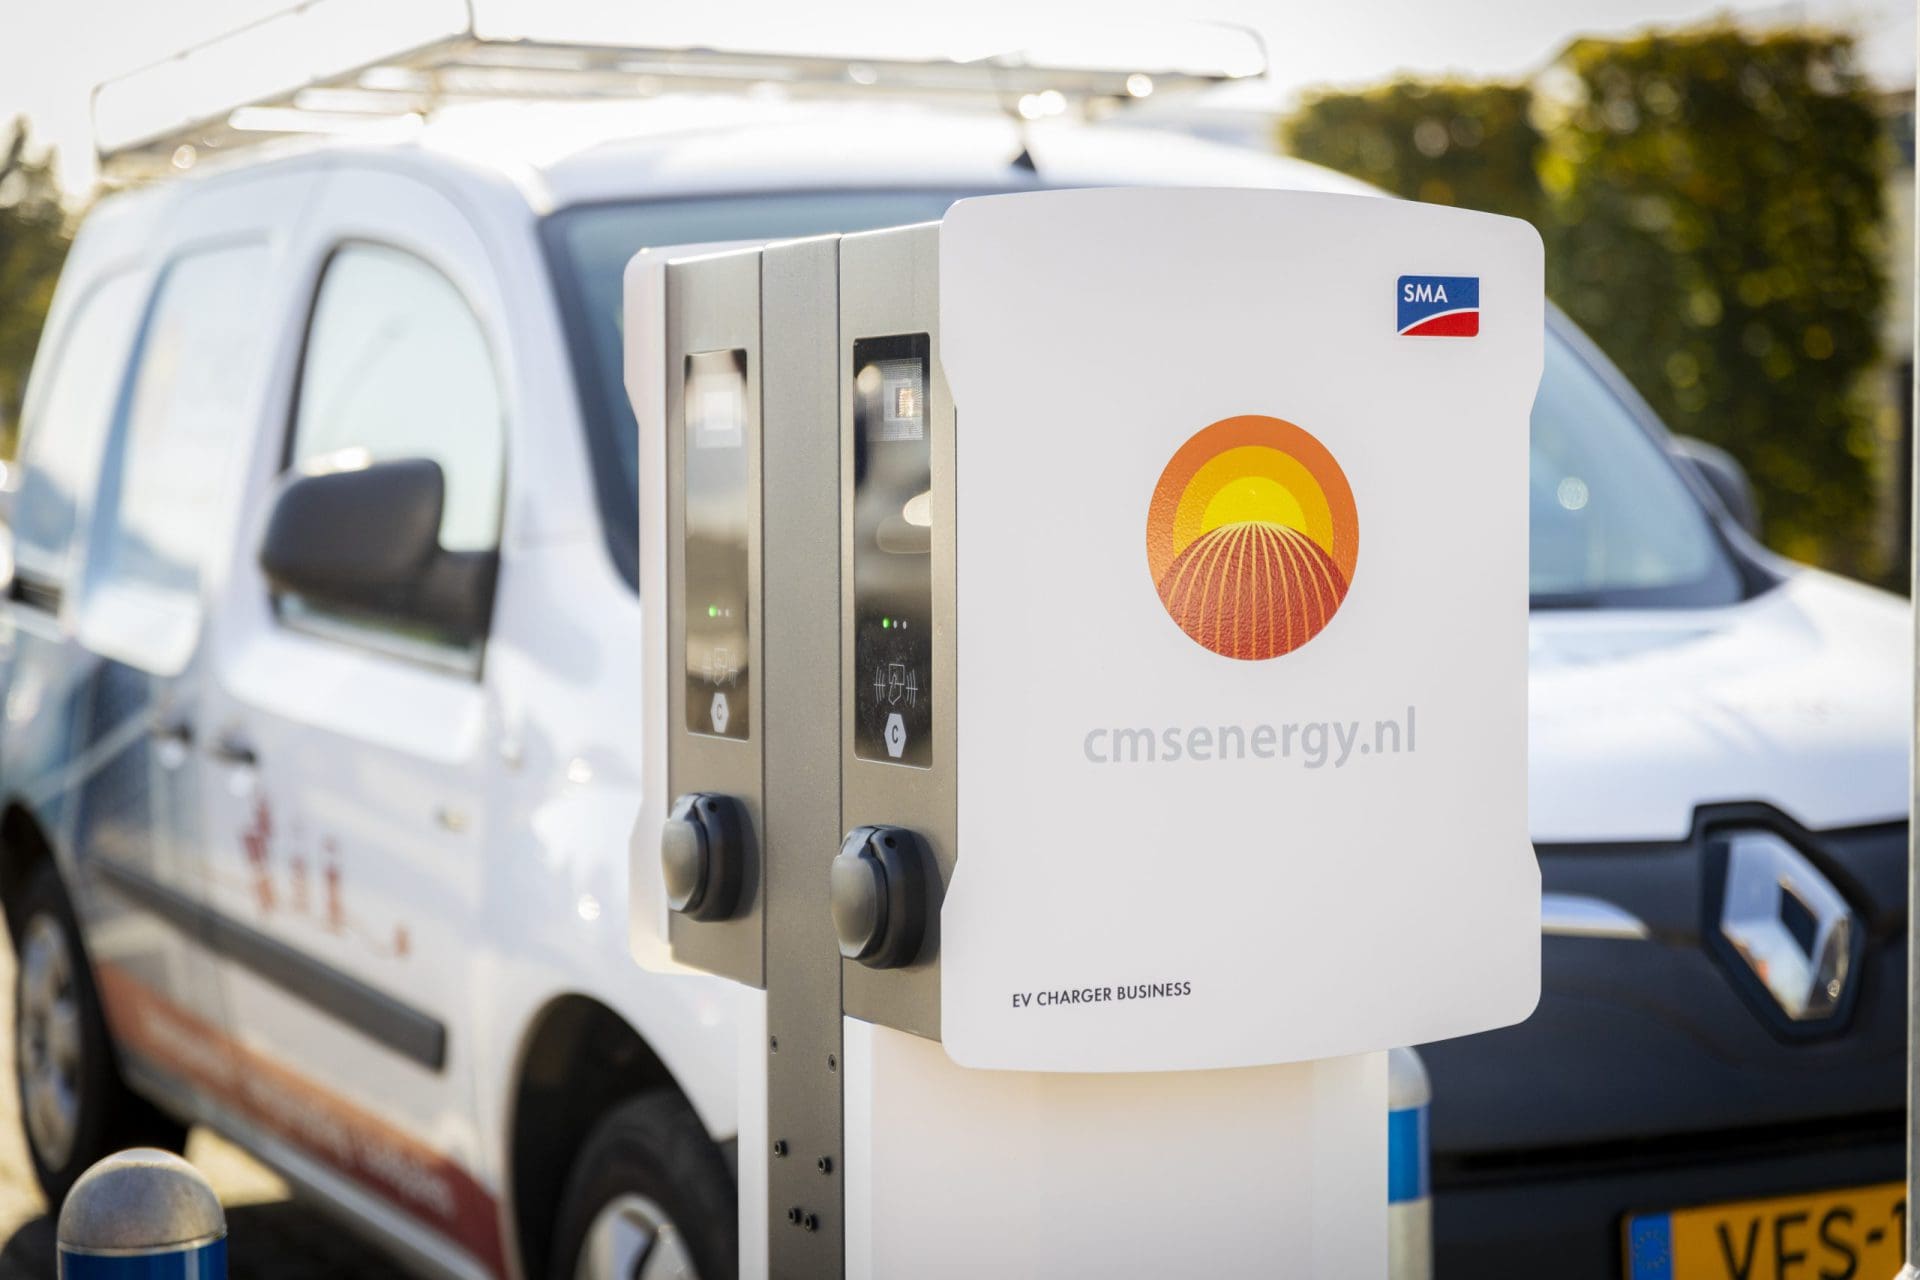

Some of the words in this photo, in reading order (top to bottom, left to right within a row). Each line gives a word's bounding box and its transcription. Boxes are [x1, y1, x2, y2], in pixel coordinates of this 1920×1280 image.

[1403, 283, 1448, 303] SMA
[1083, 705, 1416, 769] cmsenergy.nl
[1012, 993, 1032, 1008] EV
[1036, 987, 1112, 1006] CHARGER
[1117, 981, 1192, 1000] BUSINESS
